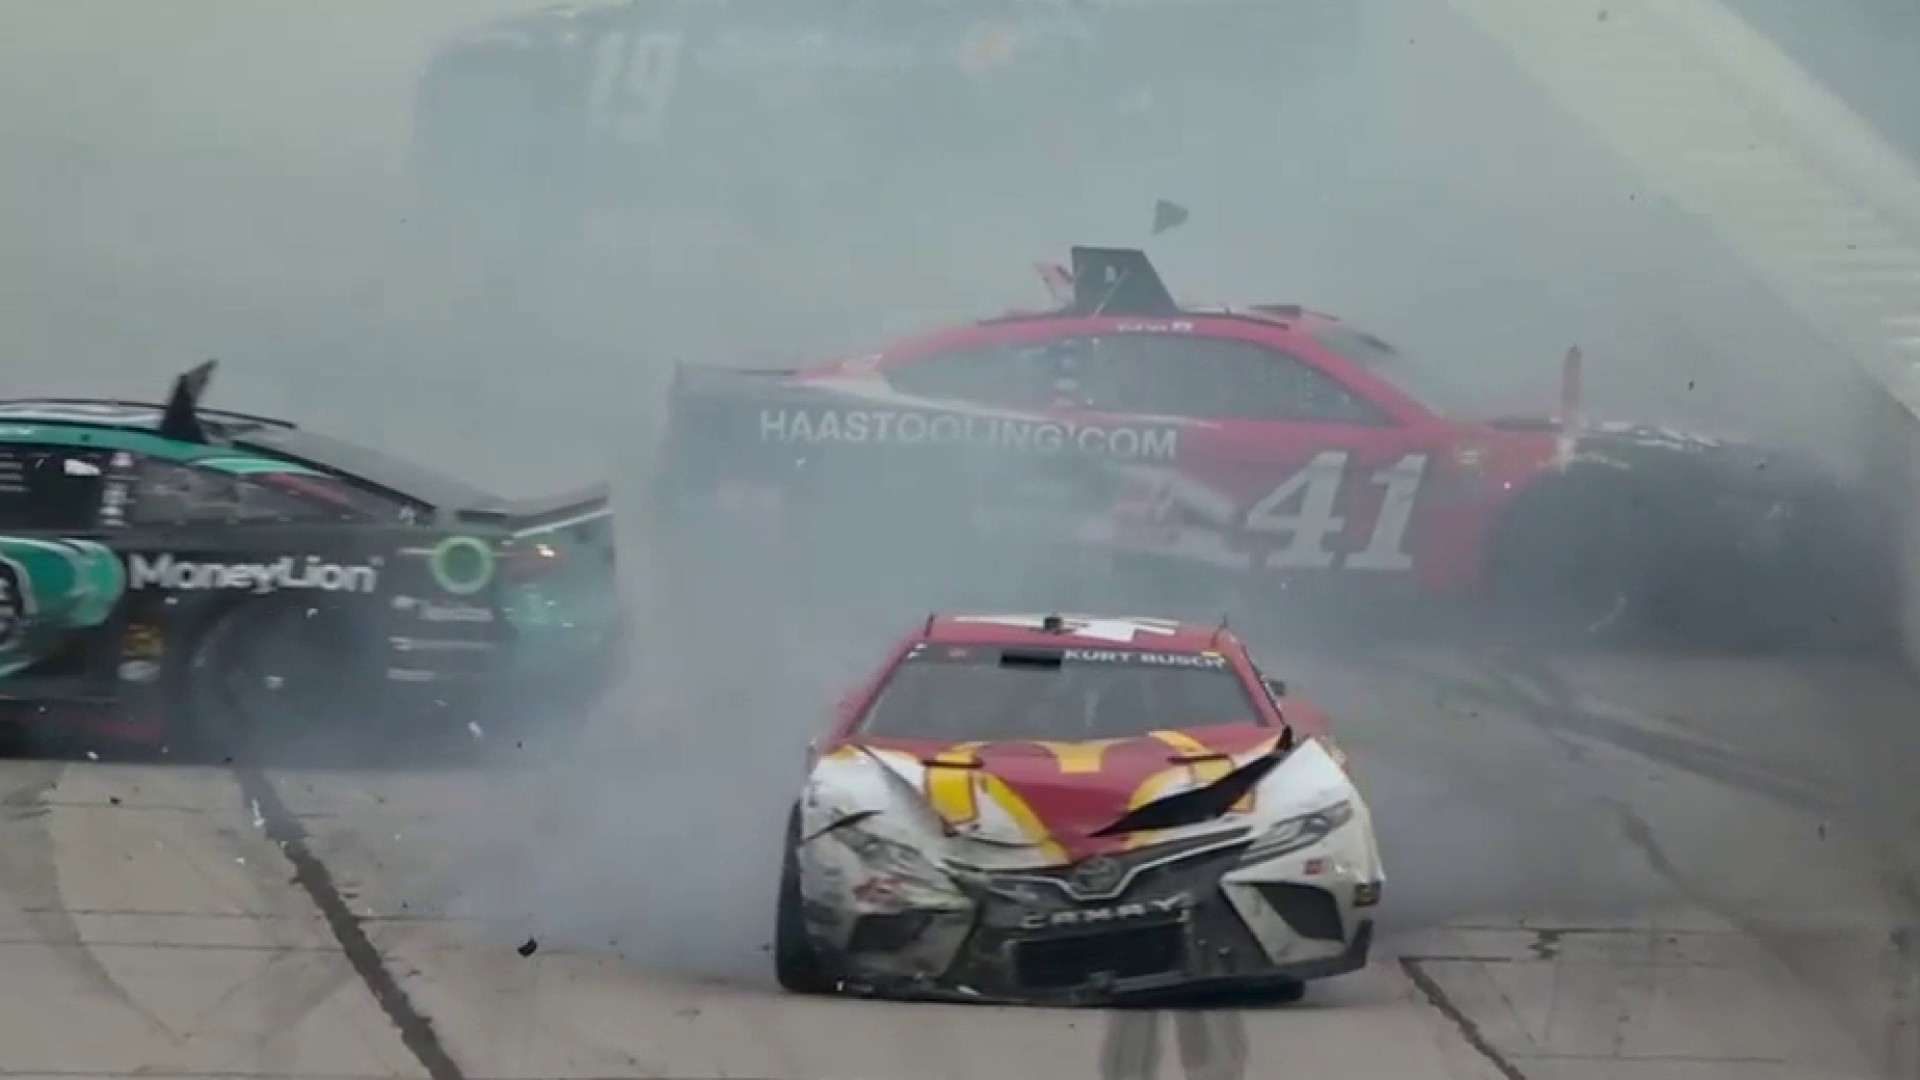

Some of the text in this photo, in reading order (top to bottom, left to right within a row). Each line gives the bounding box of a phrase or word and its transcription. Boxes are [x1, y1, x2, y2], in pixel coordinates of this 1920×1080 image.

[1244, 450, 1428, 570] 41
[128, 552, 376, 595] MoneyLion
[1064, 649, 1131, 662] KURT
